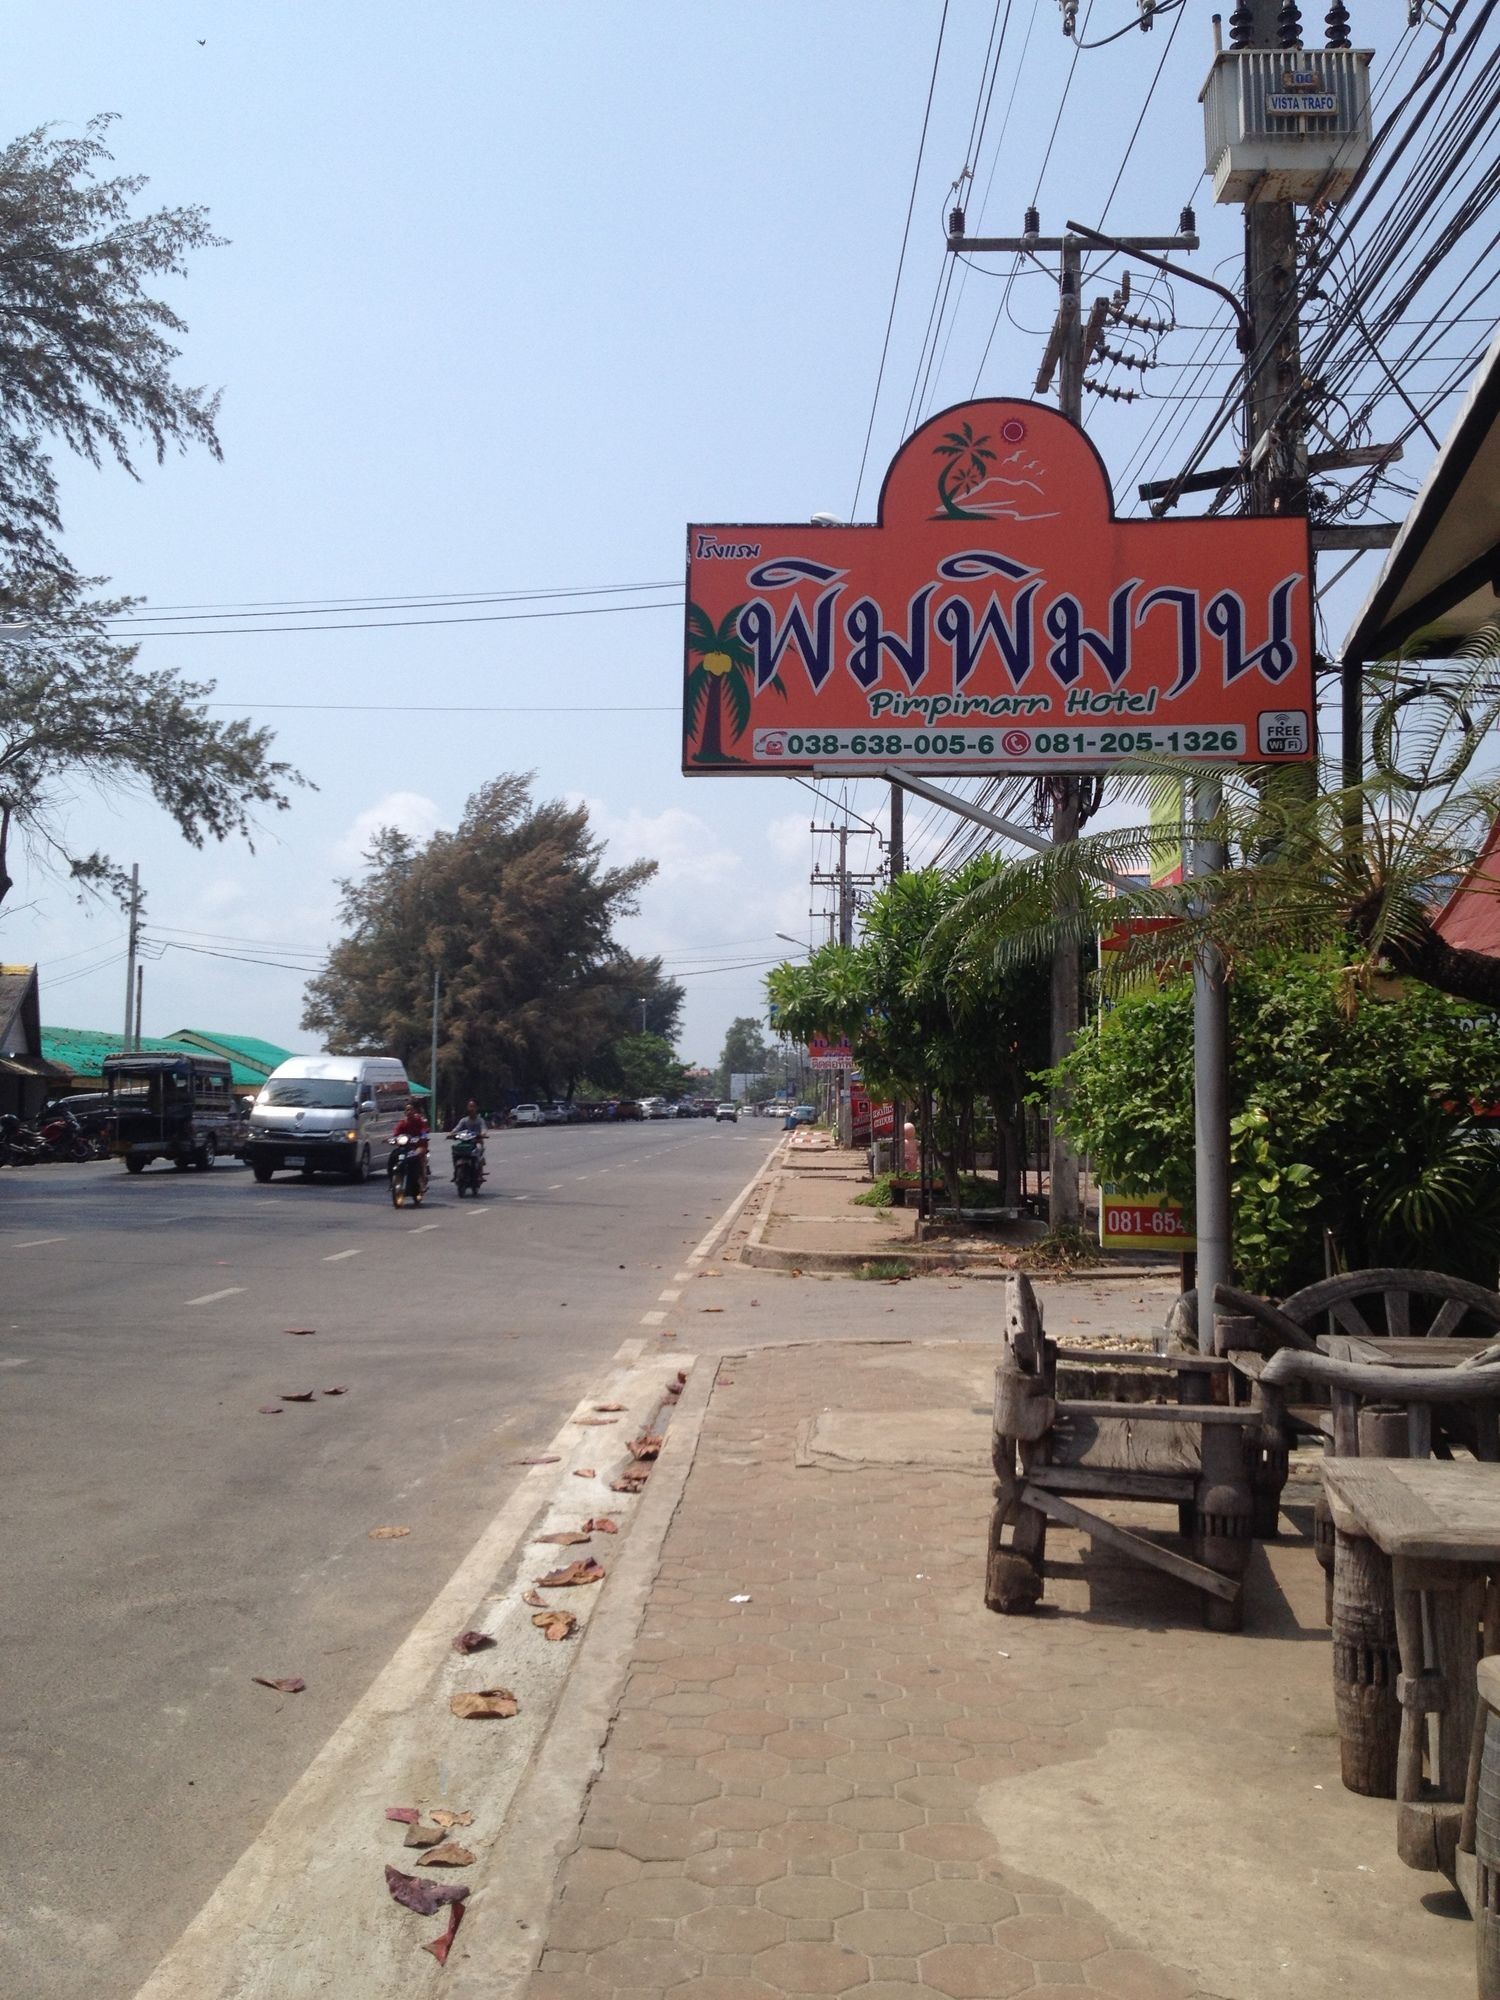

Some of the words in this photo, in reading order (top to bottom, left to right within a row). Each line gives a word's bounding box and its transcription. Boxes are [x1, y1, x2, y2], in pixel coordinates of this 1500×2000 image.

[1272, 97, 1299, 109] VISTA
[1302, 97, 1333, 109] TRAFO
[697, 535, 761, 559] โรงแรม
[737, 551, 1304, 699] พิมพิมาน
[868, 691, 1050, 726] Pimpimarn
[1066, 688, 1158, 715] Hotel
[1035, 731, 1238, 754] 081-205-1326
[1268, 726, 1301, 736] FREE
[788, 734, 995, 755] 038-638-005-6
